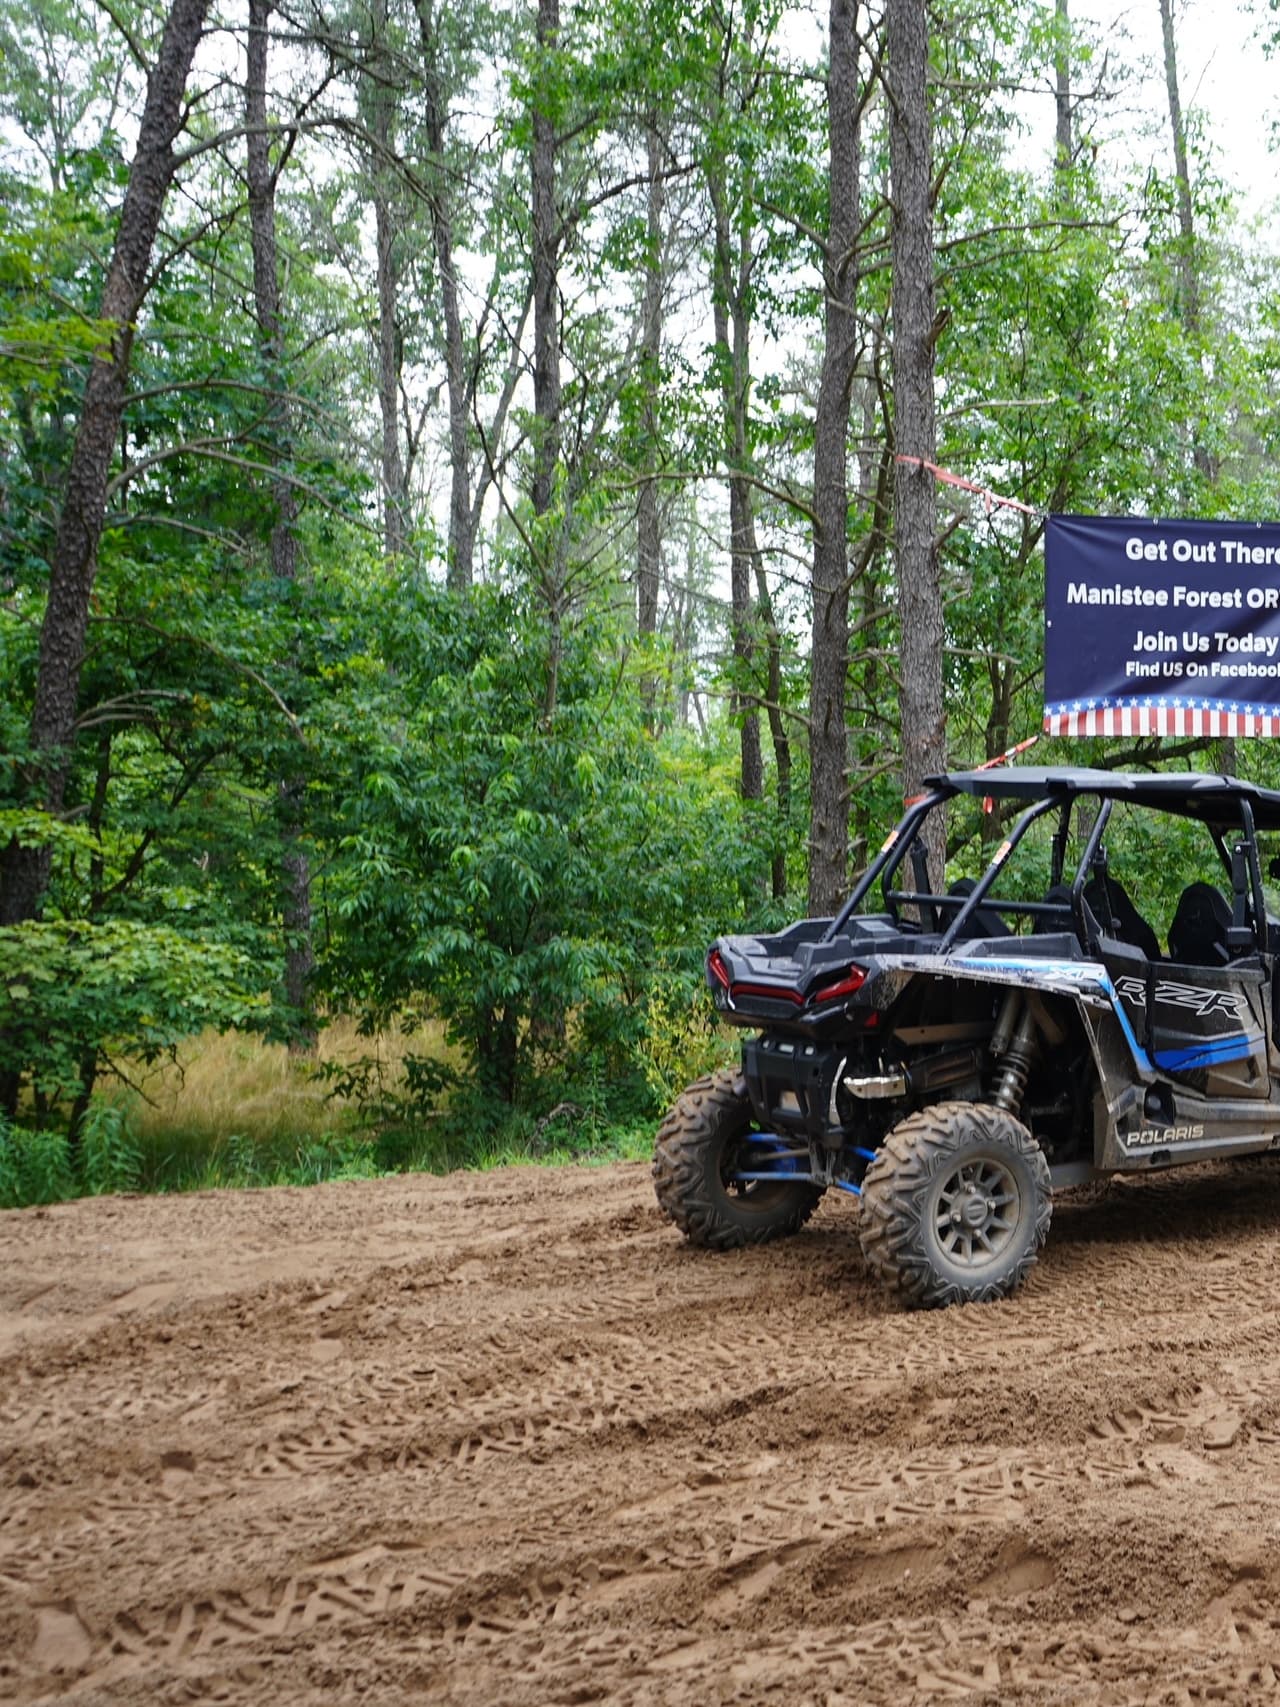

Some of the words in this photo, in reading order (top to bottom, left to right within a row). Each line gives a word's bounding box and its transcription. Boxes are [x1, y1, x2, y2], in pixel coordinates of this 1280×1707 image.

[1125, 538, 1168, 562] Get
[1172, 540, 1217, 563] Out
[1067, 583, 1168, 606] Manistee
[1173, 586, 1243, 608] Forest
[1133, 631, 1178, 652] Join
[1182, 631, 1210, 653] Us
[1214, 633, 1279, 657] Today
[1162, 662, 1183, 678] US
[1185, 663, 1209, 678] On
[1114, 975, 1248, 1020] RZR
[1127, 1124, 1204, 1146] POLARIS
